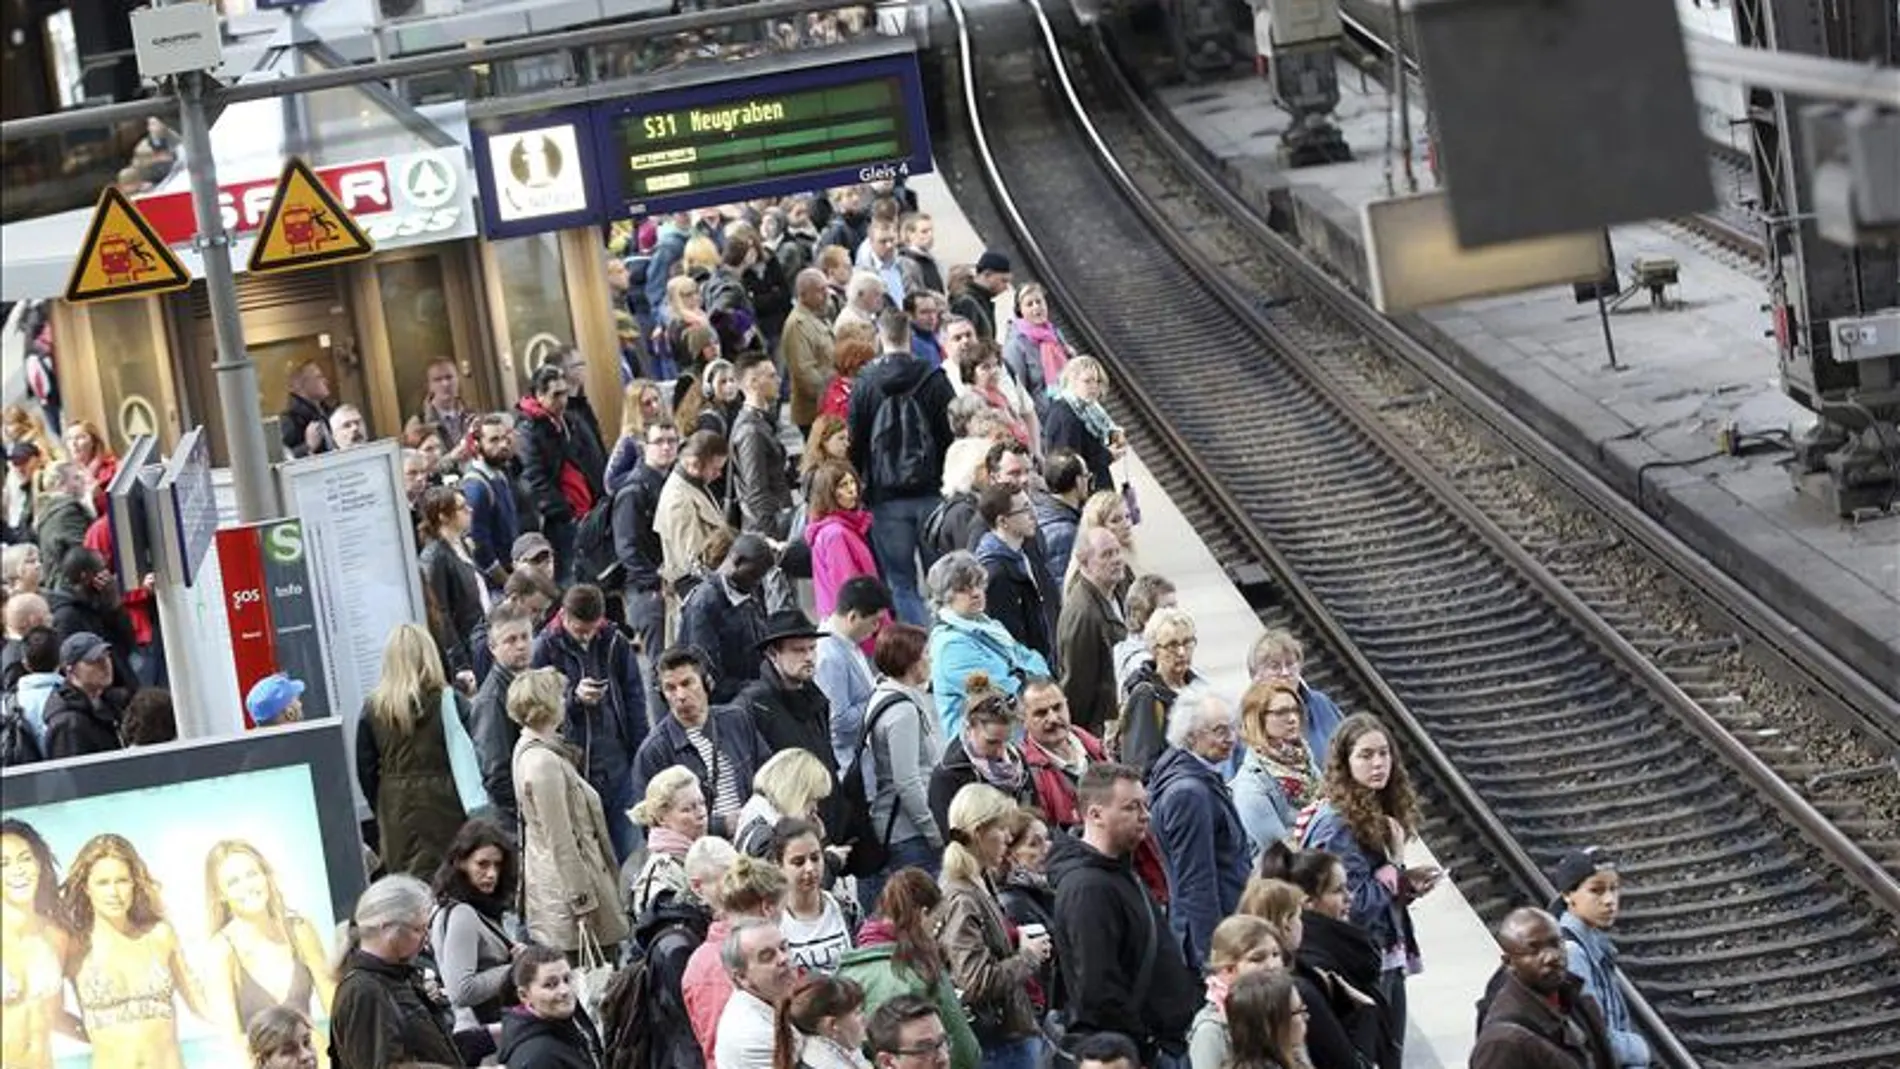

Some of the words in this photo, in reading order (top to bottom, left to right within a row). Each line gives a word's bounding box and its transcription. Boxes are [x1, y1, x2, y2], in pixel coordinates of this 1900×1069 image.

[643, 113, 677, 138] S31
[859, 163, 896, 181] Gleis
[899, 161, 909, 176] 4
[272, 523, 303, 561] S
